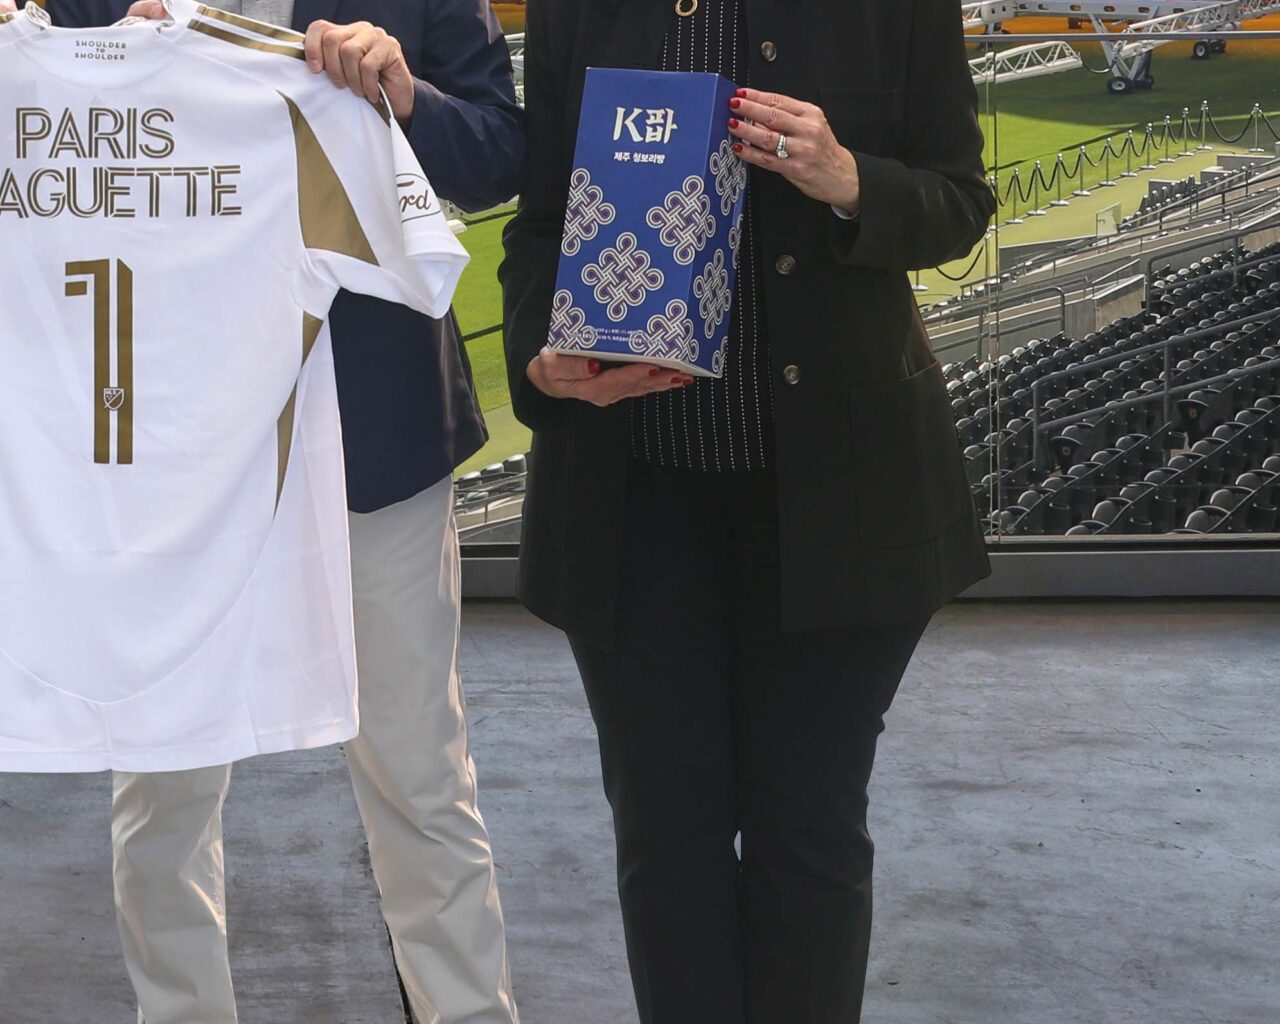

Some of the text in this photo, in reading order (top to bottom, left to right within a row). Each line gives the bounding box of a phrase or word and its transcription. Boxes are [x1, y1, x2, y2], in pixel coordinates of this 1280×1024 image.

[75, 40, 127, 49] SHOULDER
[74, 52, 125, 61] SHOULDER
[15, 107, 176, 159] PARIS
[613, 151, 631, 162] 제주
[65, 257, 133, 464] 1
